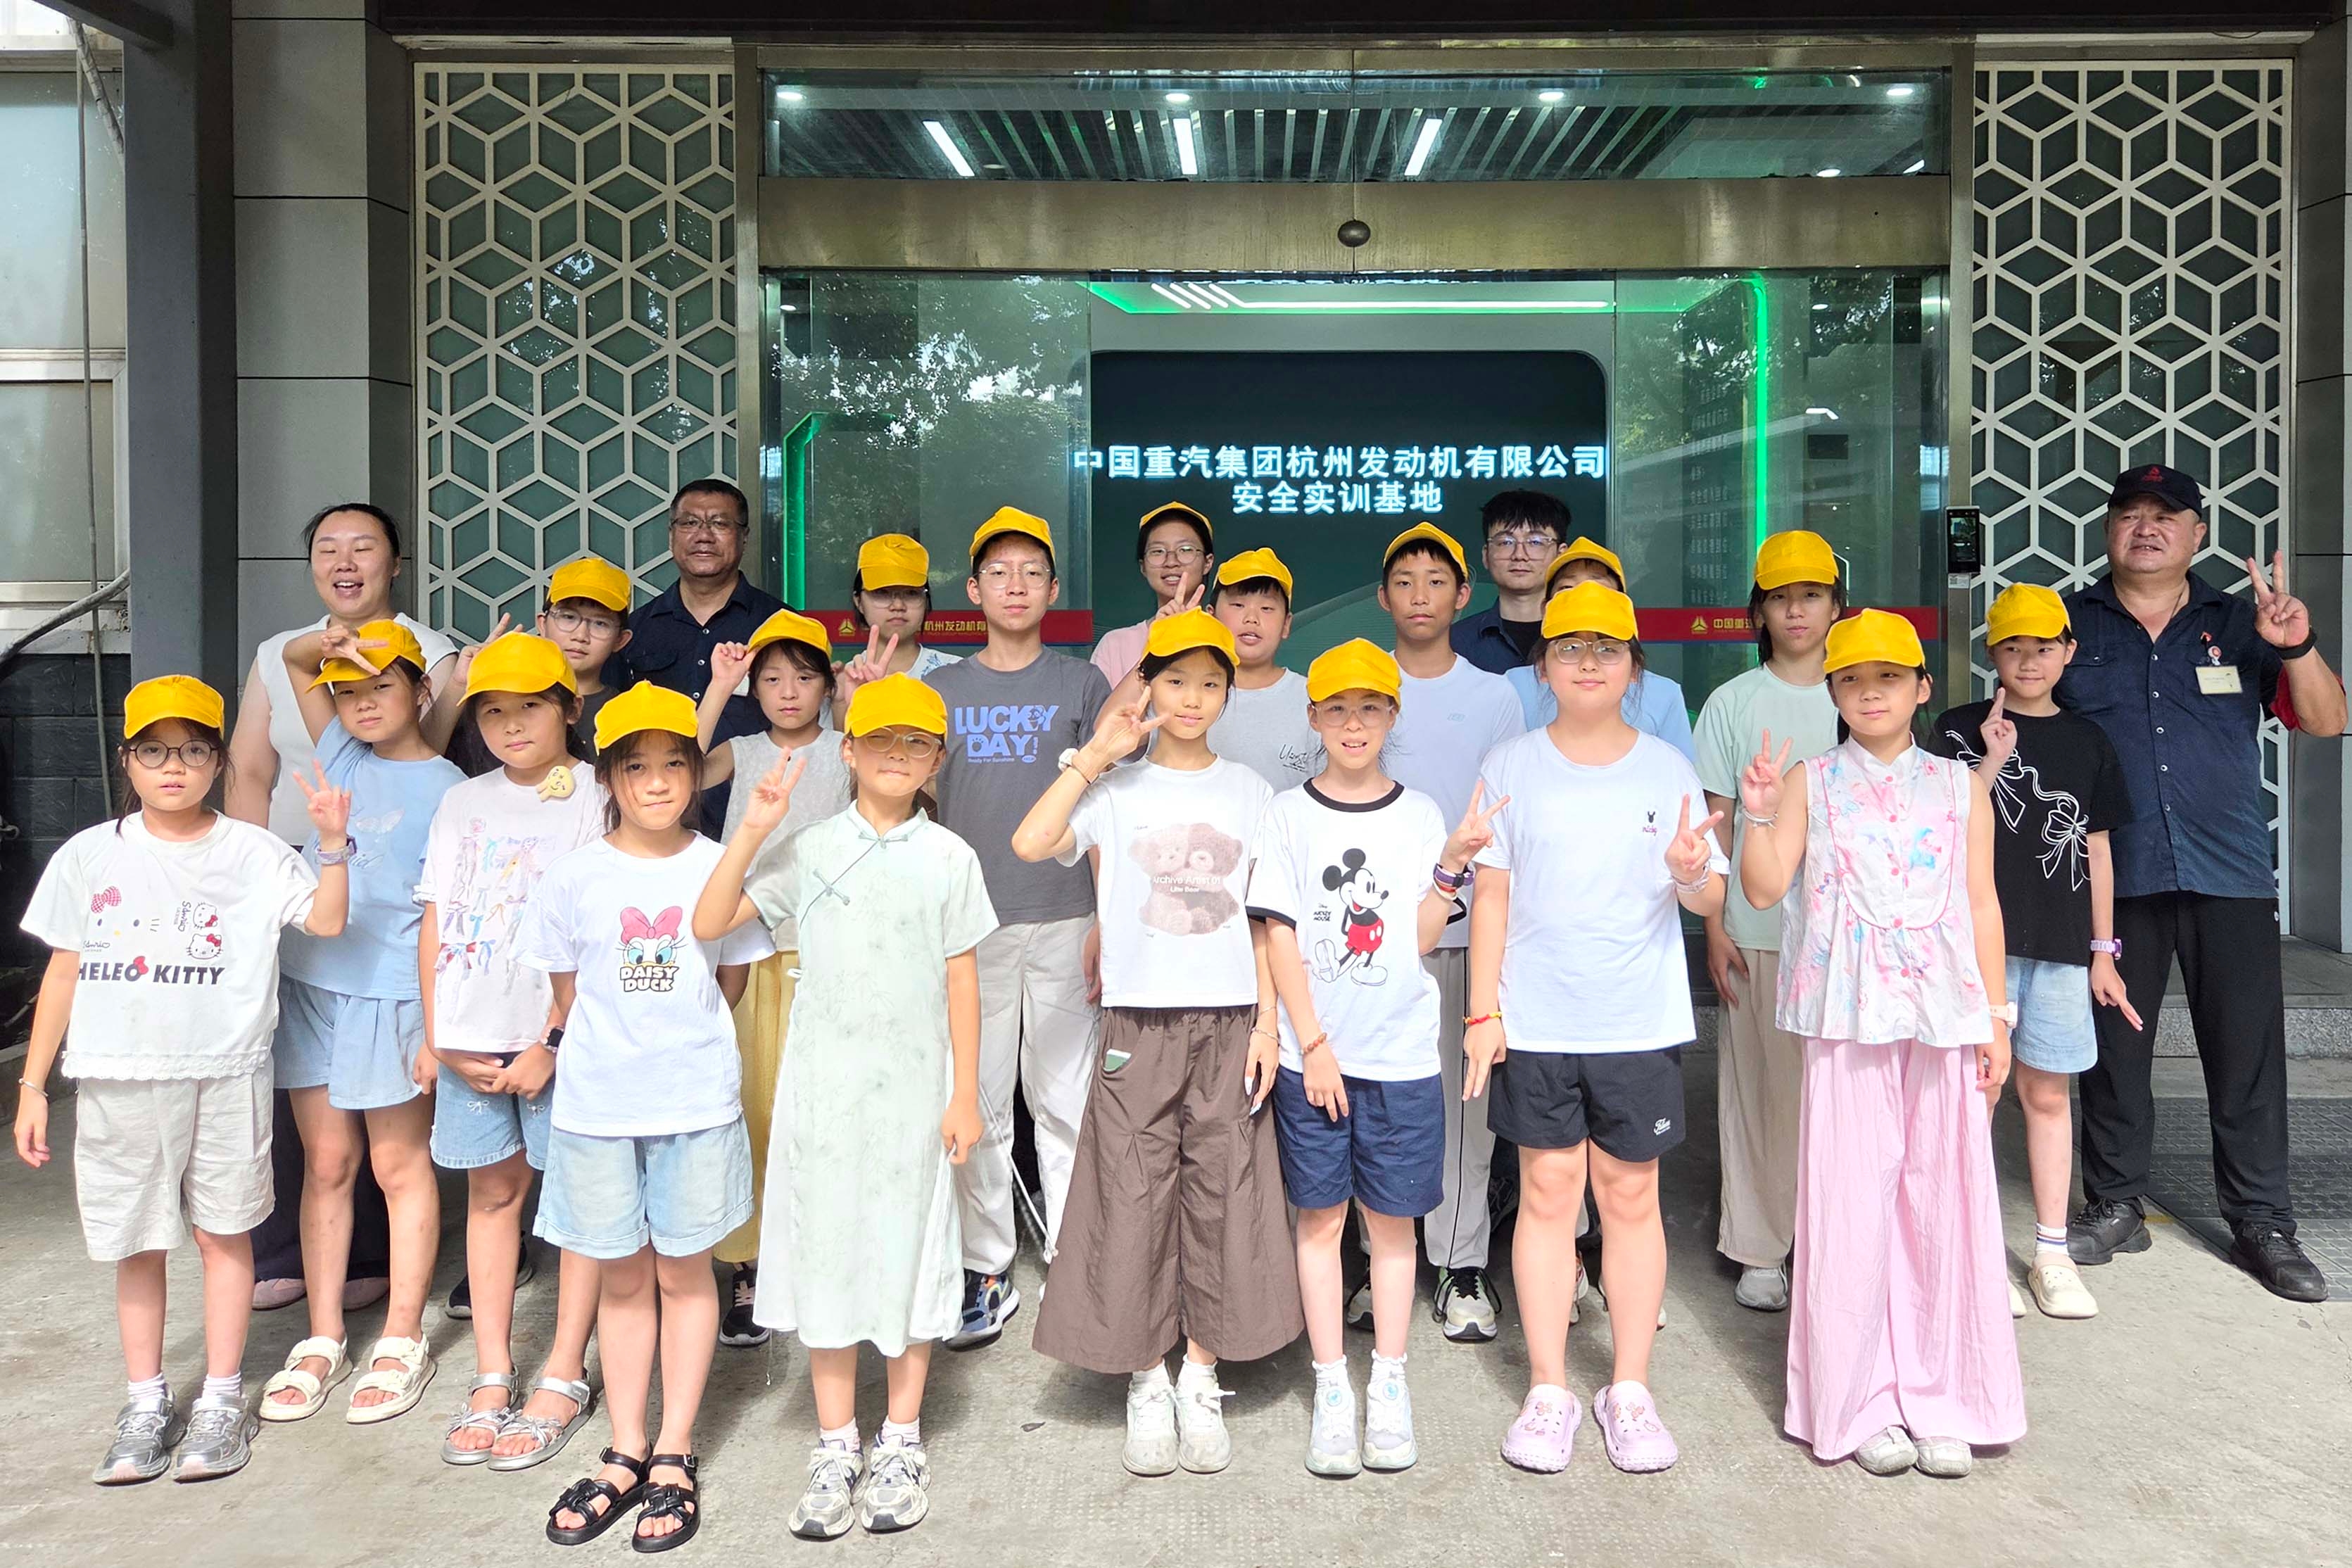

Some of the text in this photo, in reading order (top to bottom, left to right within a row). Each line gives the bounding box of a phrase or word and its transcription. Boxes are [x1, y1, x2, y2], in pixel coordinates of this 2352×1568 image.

[1074, 445, 1605, 479] 中国重汽集团杭州发动机有限公司
[1232, 481, 1443, 514] 安全实训基地
[954, 704, 1059, 734] LUCKY
[967, 733, 1039, 757] DAY!
[153, 965, 225, 985] KITTY
[620, 966, 679, 980] DAISY
[624, 978, 674, 992] DUCK
